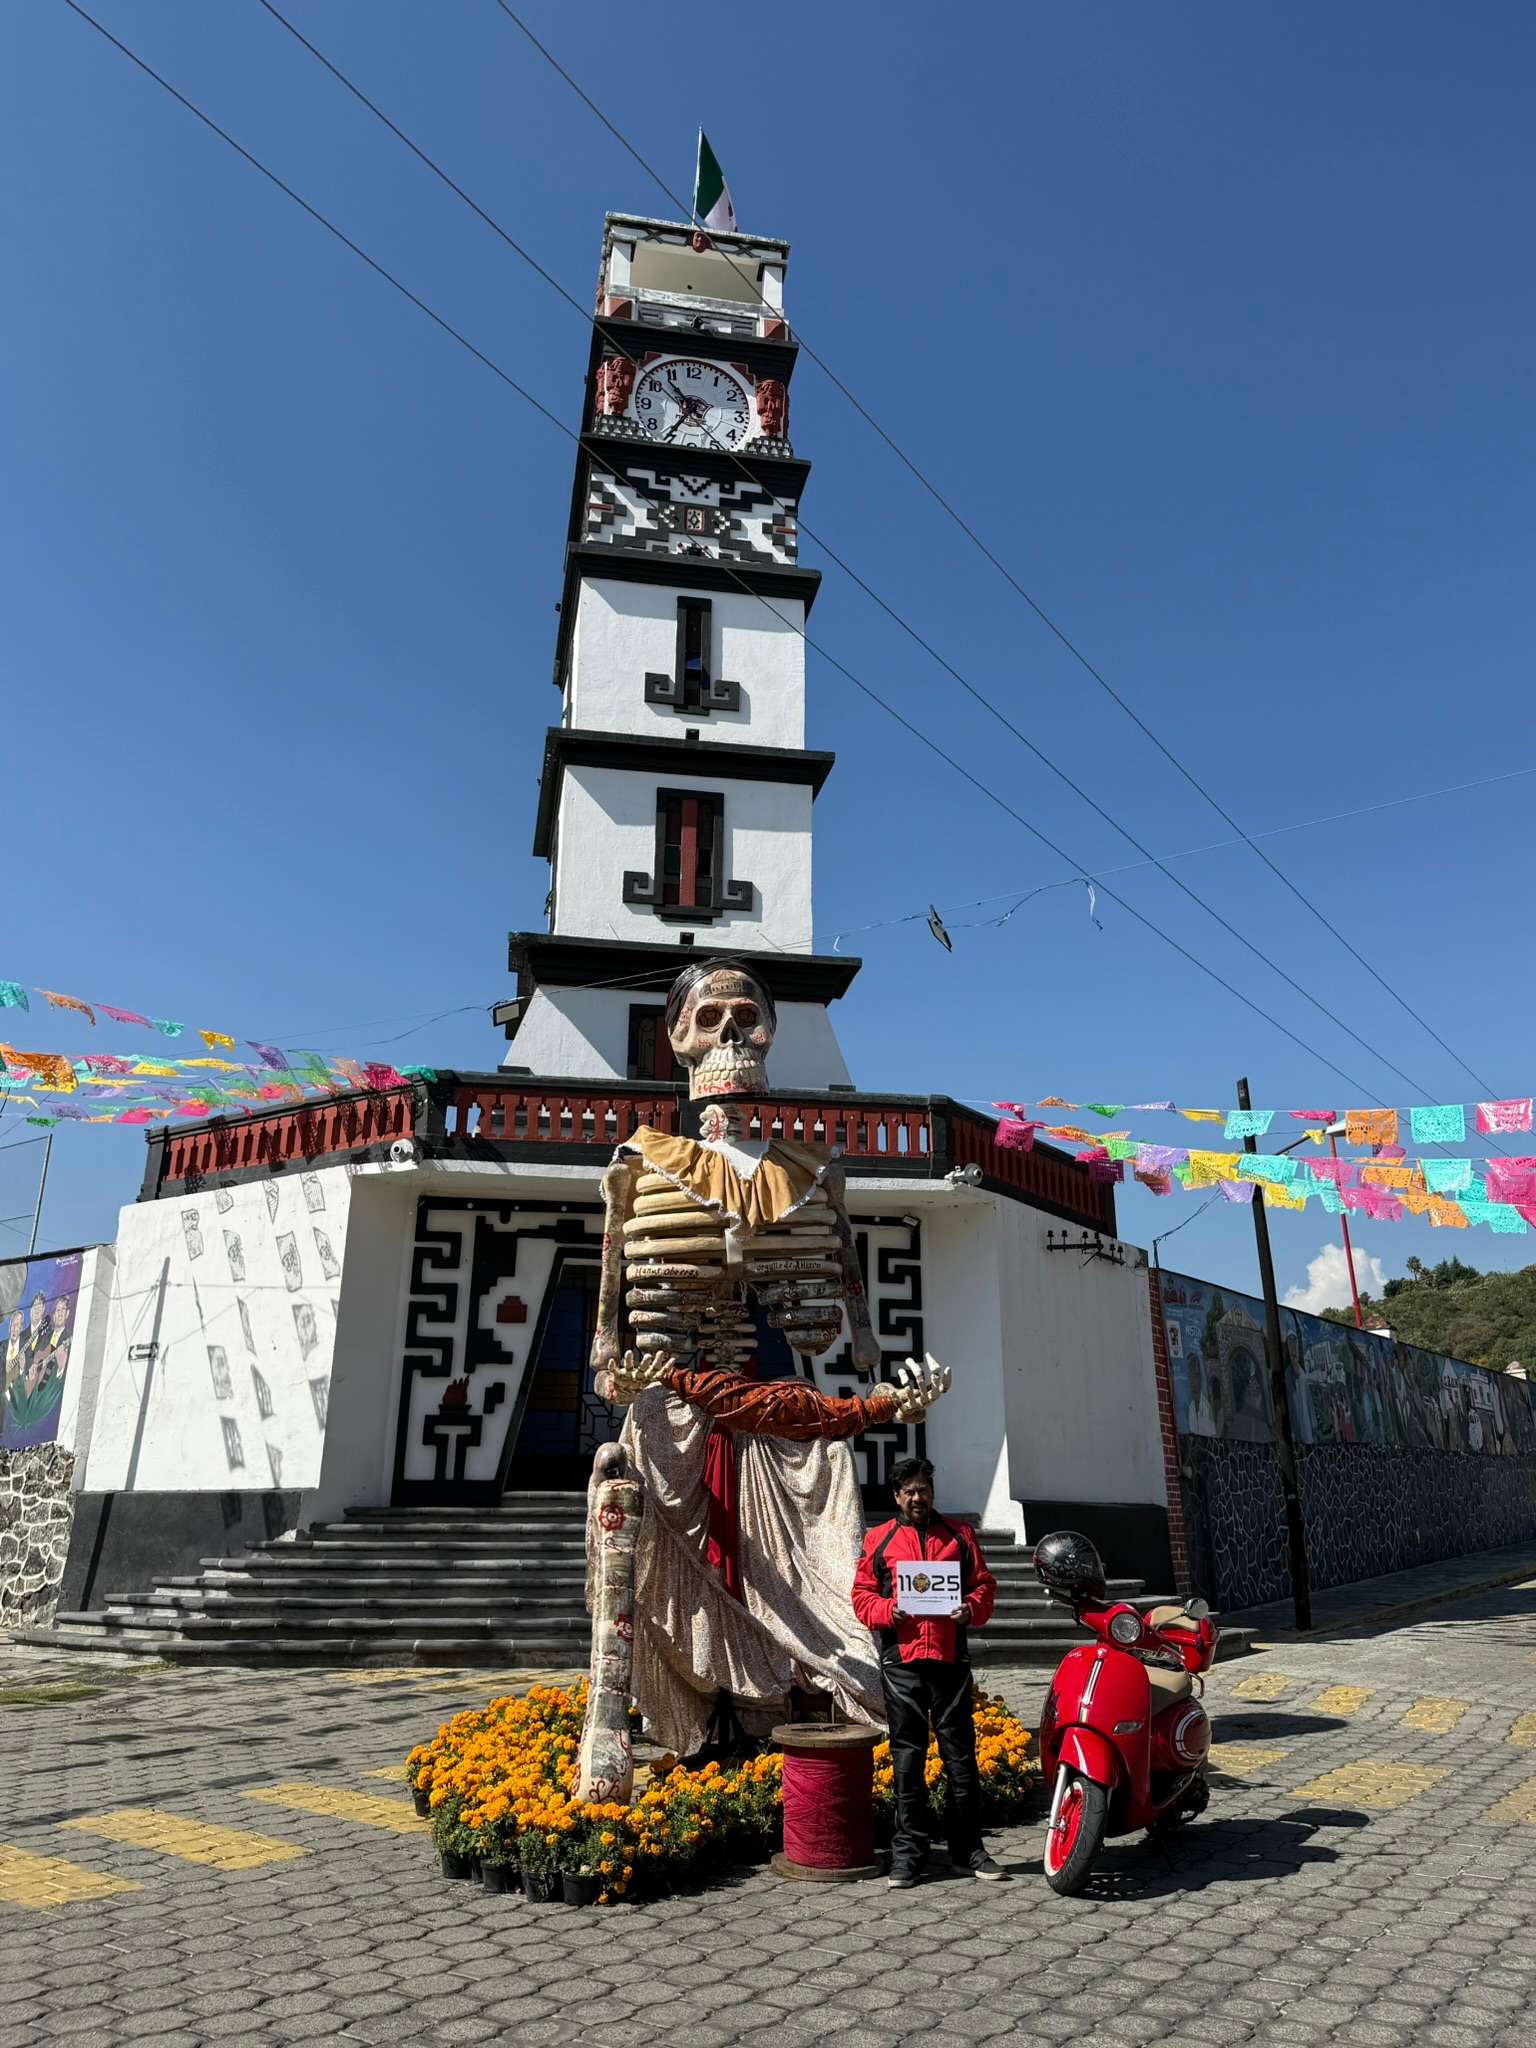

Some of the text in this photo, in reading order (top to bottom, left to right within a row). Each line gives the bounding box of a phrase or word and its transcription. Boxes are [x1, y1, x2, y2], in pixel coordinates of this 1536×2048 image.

[666, 368, 677, 381] 11
[687, 367, 702, 379] 12
[649, 380, 662, 392] 10
[714, 376, 719, 387] 1
[727, 389, 737, 402] 2
[640, 397, 652, 410] 9
[734, 411, 745, 423] 3
[647, 418, 658, 430] 8
[726, 429, 737, 441] 4
